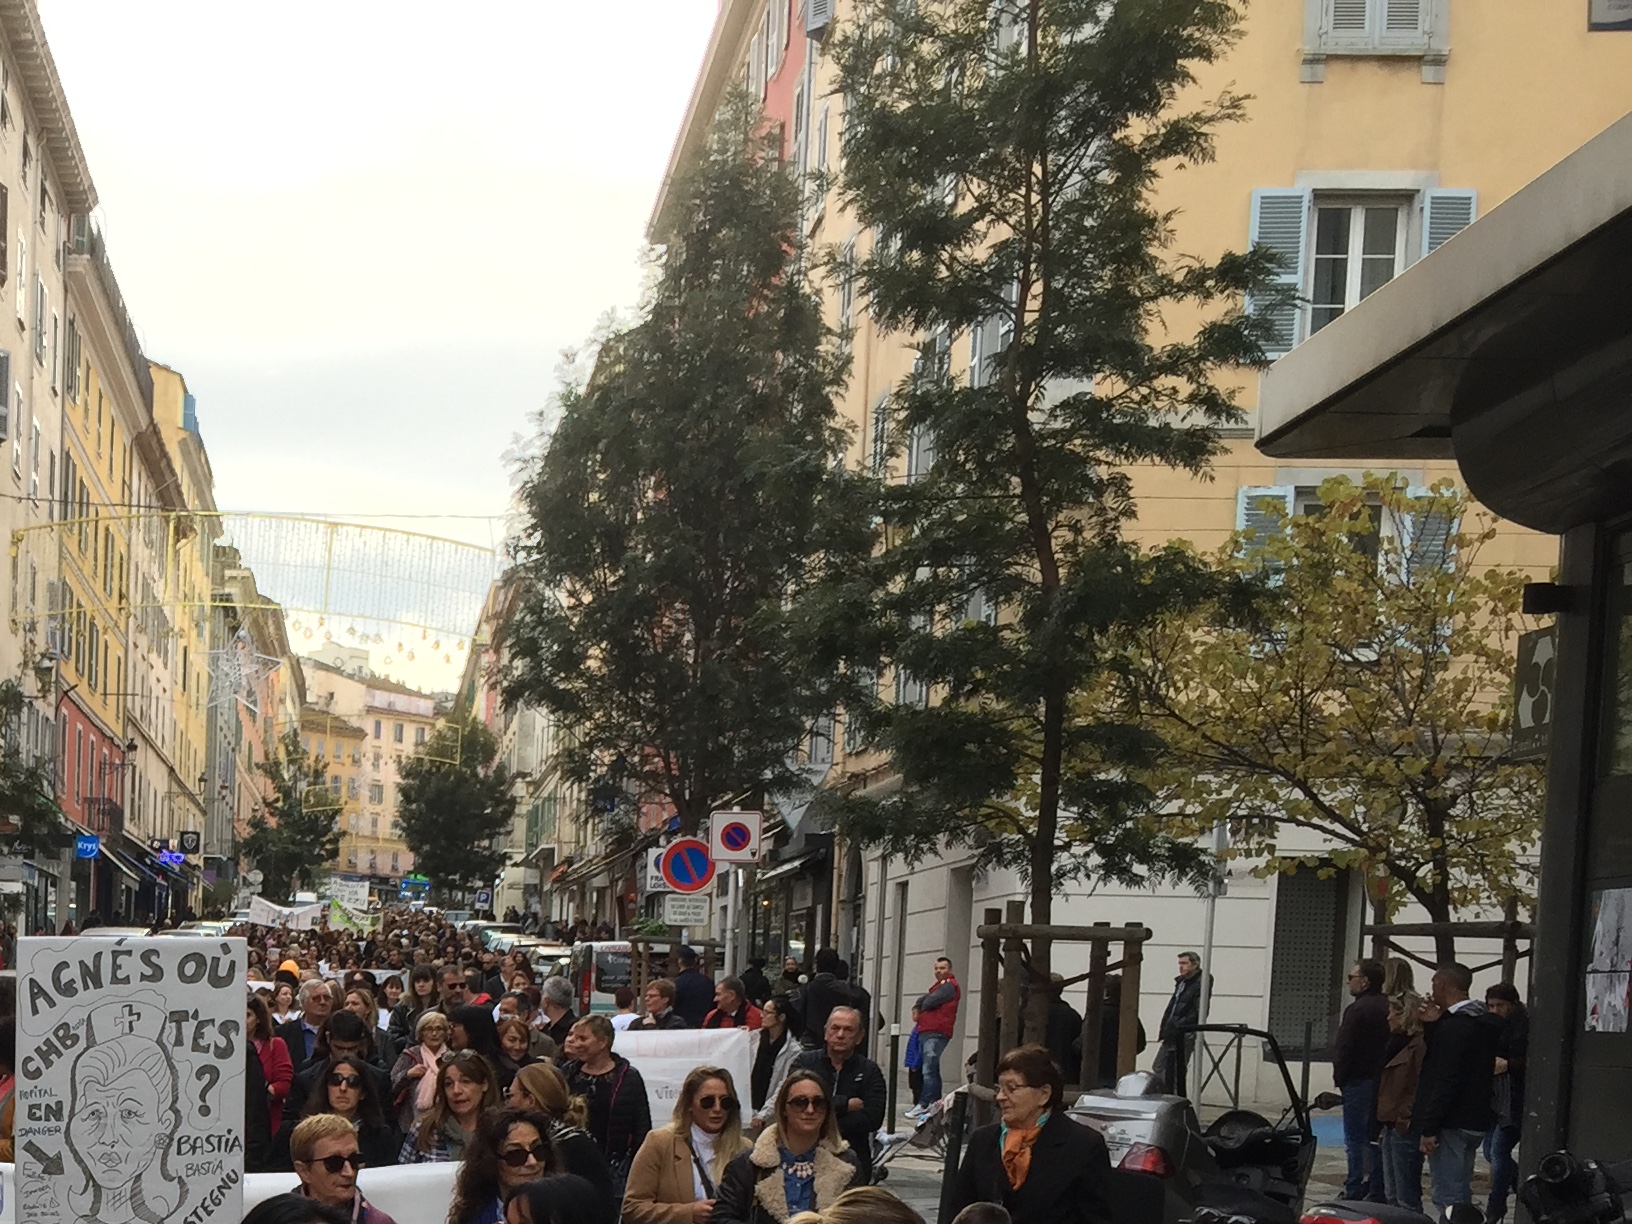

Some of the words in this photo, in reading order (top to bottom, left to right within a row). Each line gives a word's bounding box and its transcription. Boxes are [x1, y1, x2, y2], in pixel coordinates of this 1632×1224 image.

[77, 840, 96, 854] Krys
[28, 937, 164, 1017] AGNÉS
[176, 942, 236, 989] OÙ
[21, 1021, 80, 1081] CHB
[167, 1008, 240, 1060] T'ES
[26, 1100, 65, 1122] EN
[195, 1064, 219, 1118] ?
[18, 1125, 62, 1138] DANGER
